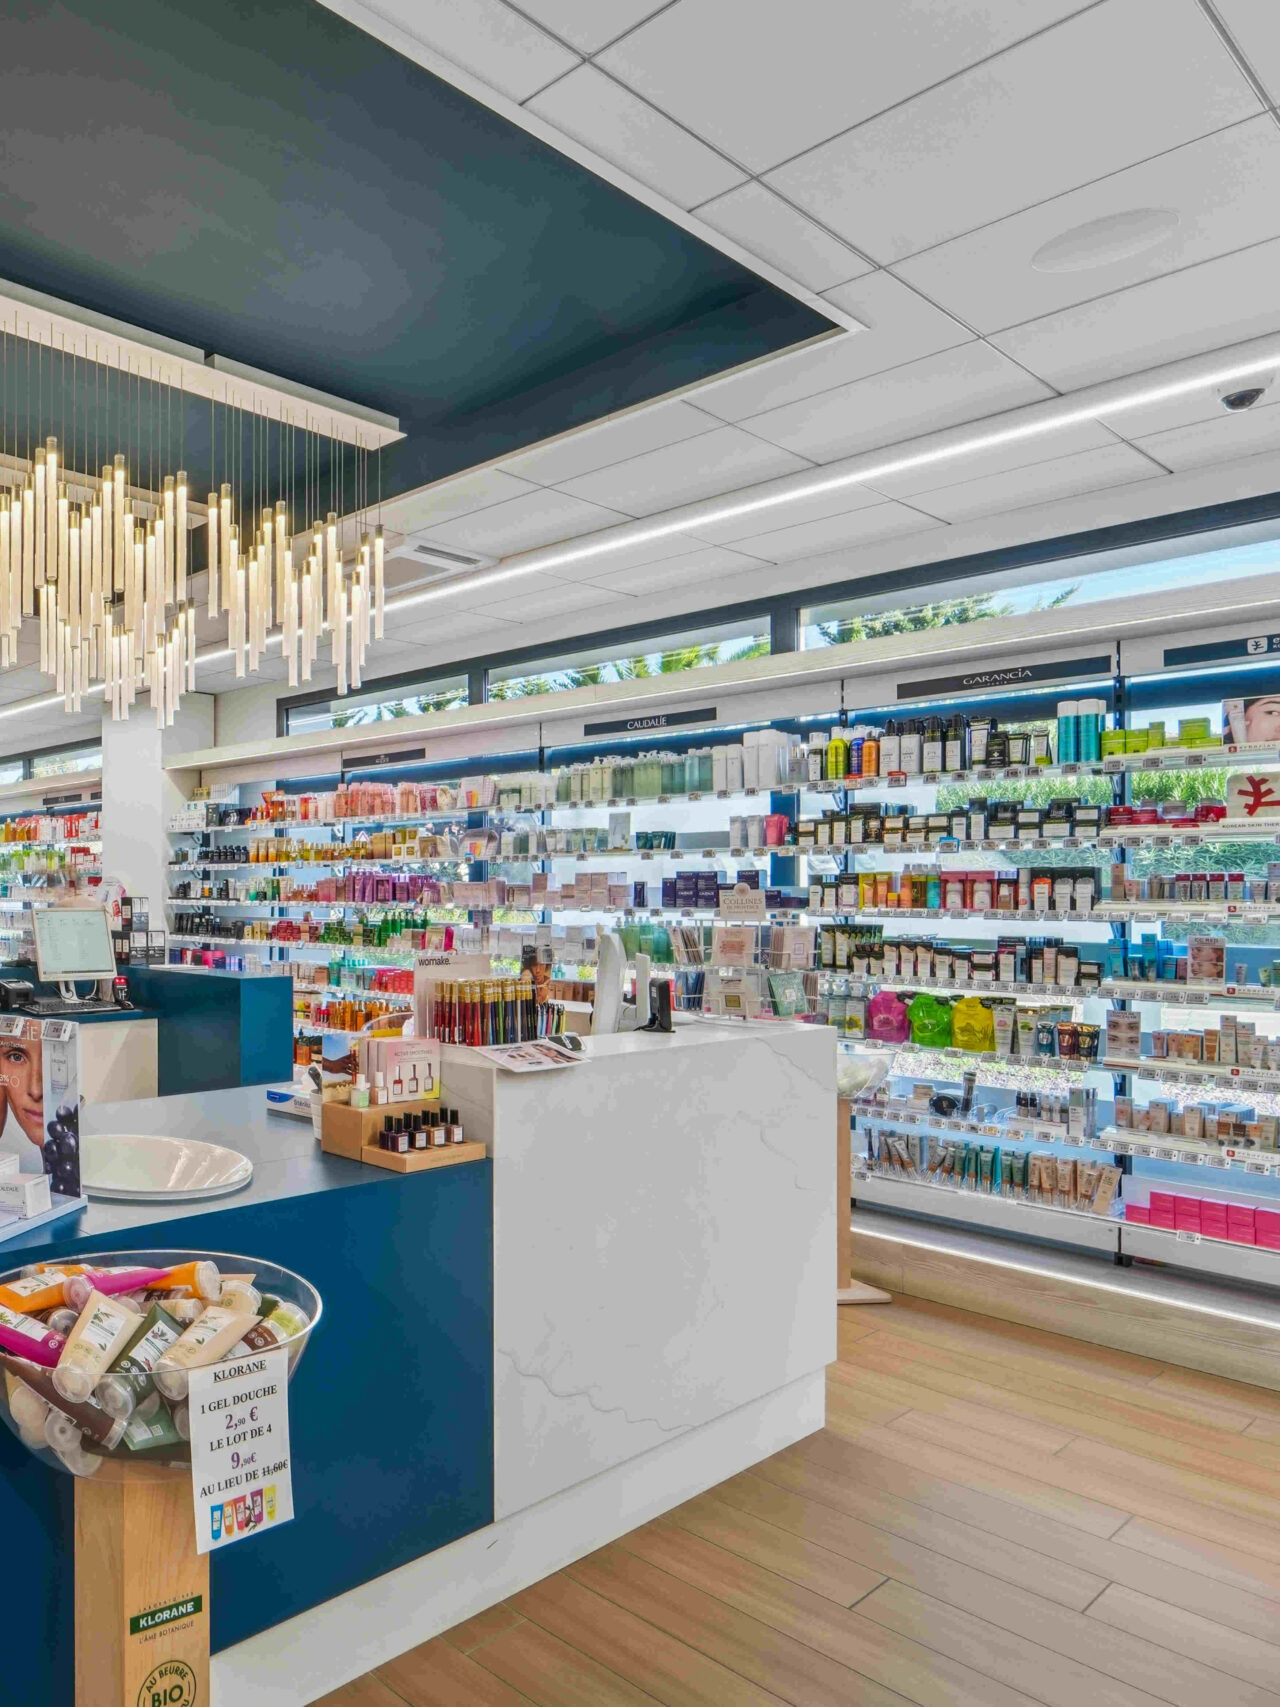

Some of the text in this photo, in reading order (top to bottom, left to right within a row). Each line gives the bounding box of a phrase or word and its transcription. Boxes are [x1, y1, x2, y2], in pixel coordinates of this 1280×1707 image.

[213, 1359, 267, 1382] KLORANE
[201, 1384, 278, 1415] 1 GEL DOUCHE
[249, 1406, 258, 1422] €
[209, 1423, 272, 1452] LE LOT DE 4
[200, 1483, 215, 1498] AU
[217, 1475, 243, 1492] LIEU
[245, 1469, 260, 1483] DE
[139, 1601, 195, 1629] KLORANE
[139, 1620, 195, 1644] L'ÂME BOTANIQUE
[145, 1665, 189, 1693] AU BEURRE
[151, 1684, 184, 1707] BIO
